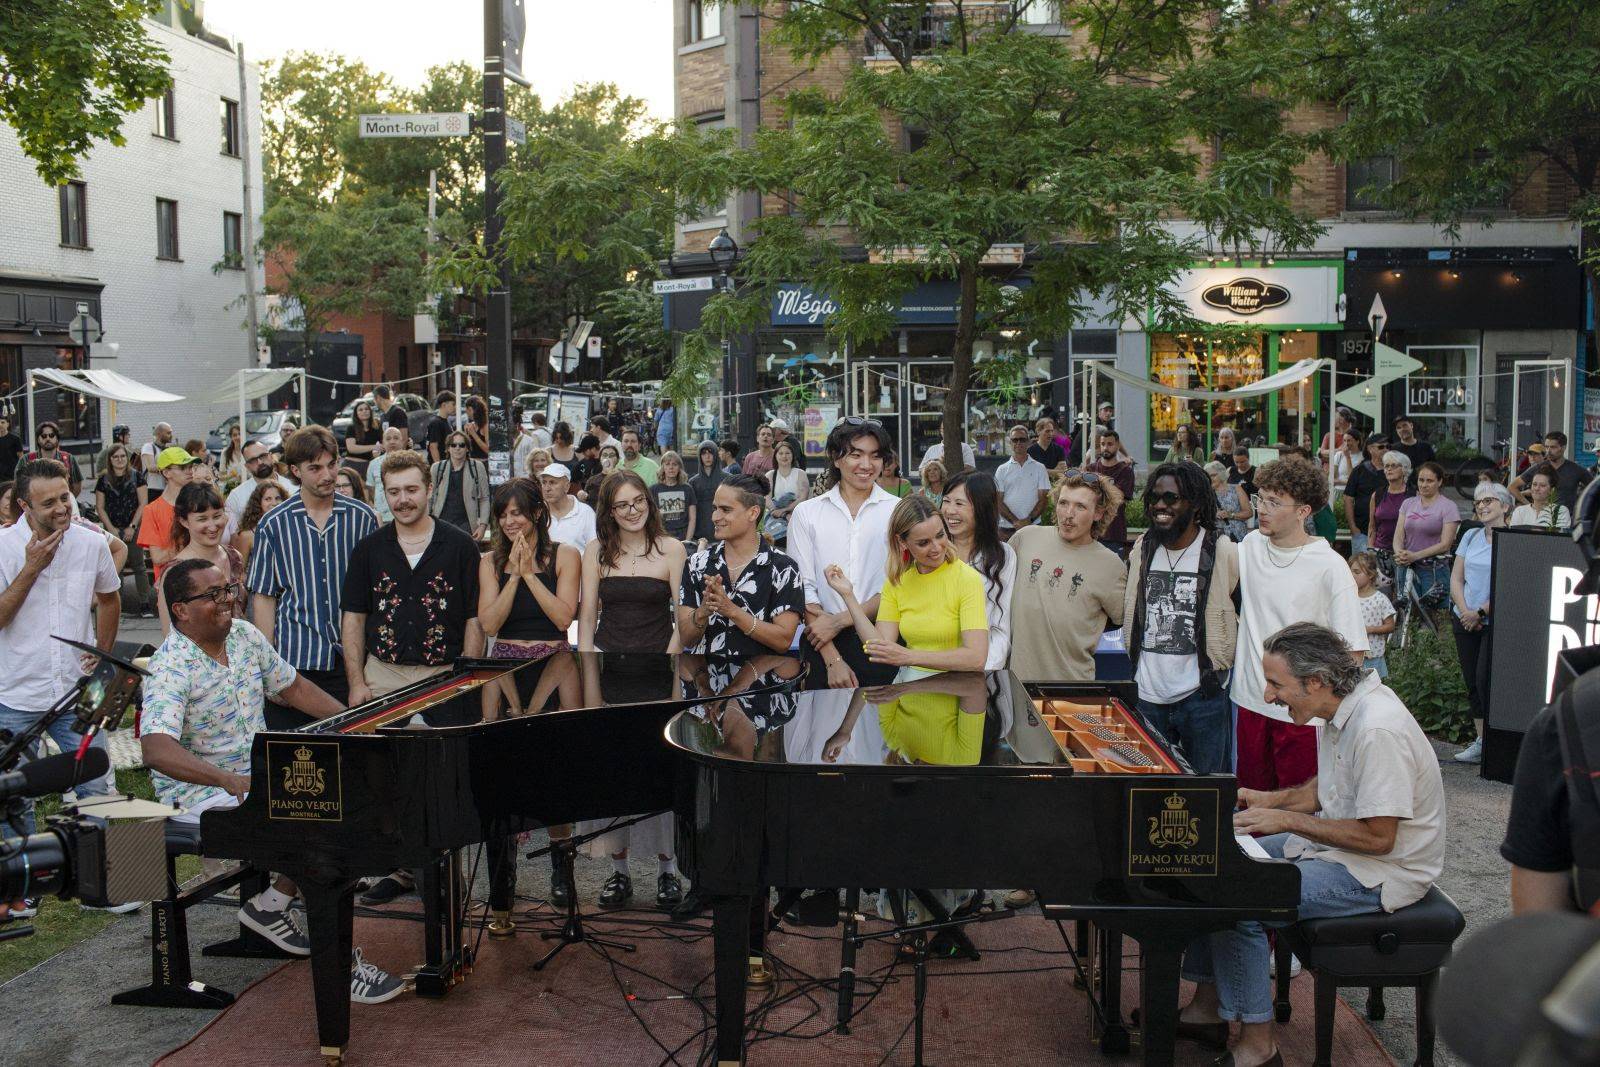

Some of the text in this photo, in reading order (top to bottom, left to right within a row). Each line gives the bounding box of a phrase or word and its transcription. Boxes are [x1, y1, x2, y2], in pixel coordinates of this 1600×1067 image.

[366, 121, 440, 134] Mont-Royal
[656, 282, 697, 292] Mont-Royal
[1223, 286, 1270, 297] William J.
[777, 290, 837, 323] Méga
[1230, 296, 1260, 306] Walter
[1341, 339, 1372, 354] 1957
[1411, 388, 1474, 406] LOFT 206
[271, 800, 339, 811] PIANO VERTU
[1132, 854, 1215, 866] PIANO VERTU
[158, 908, 170, 985] PIANO VERTU
